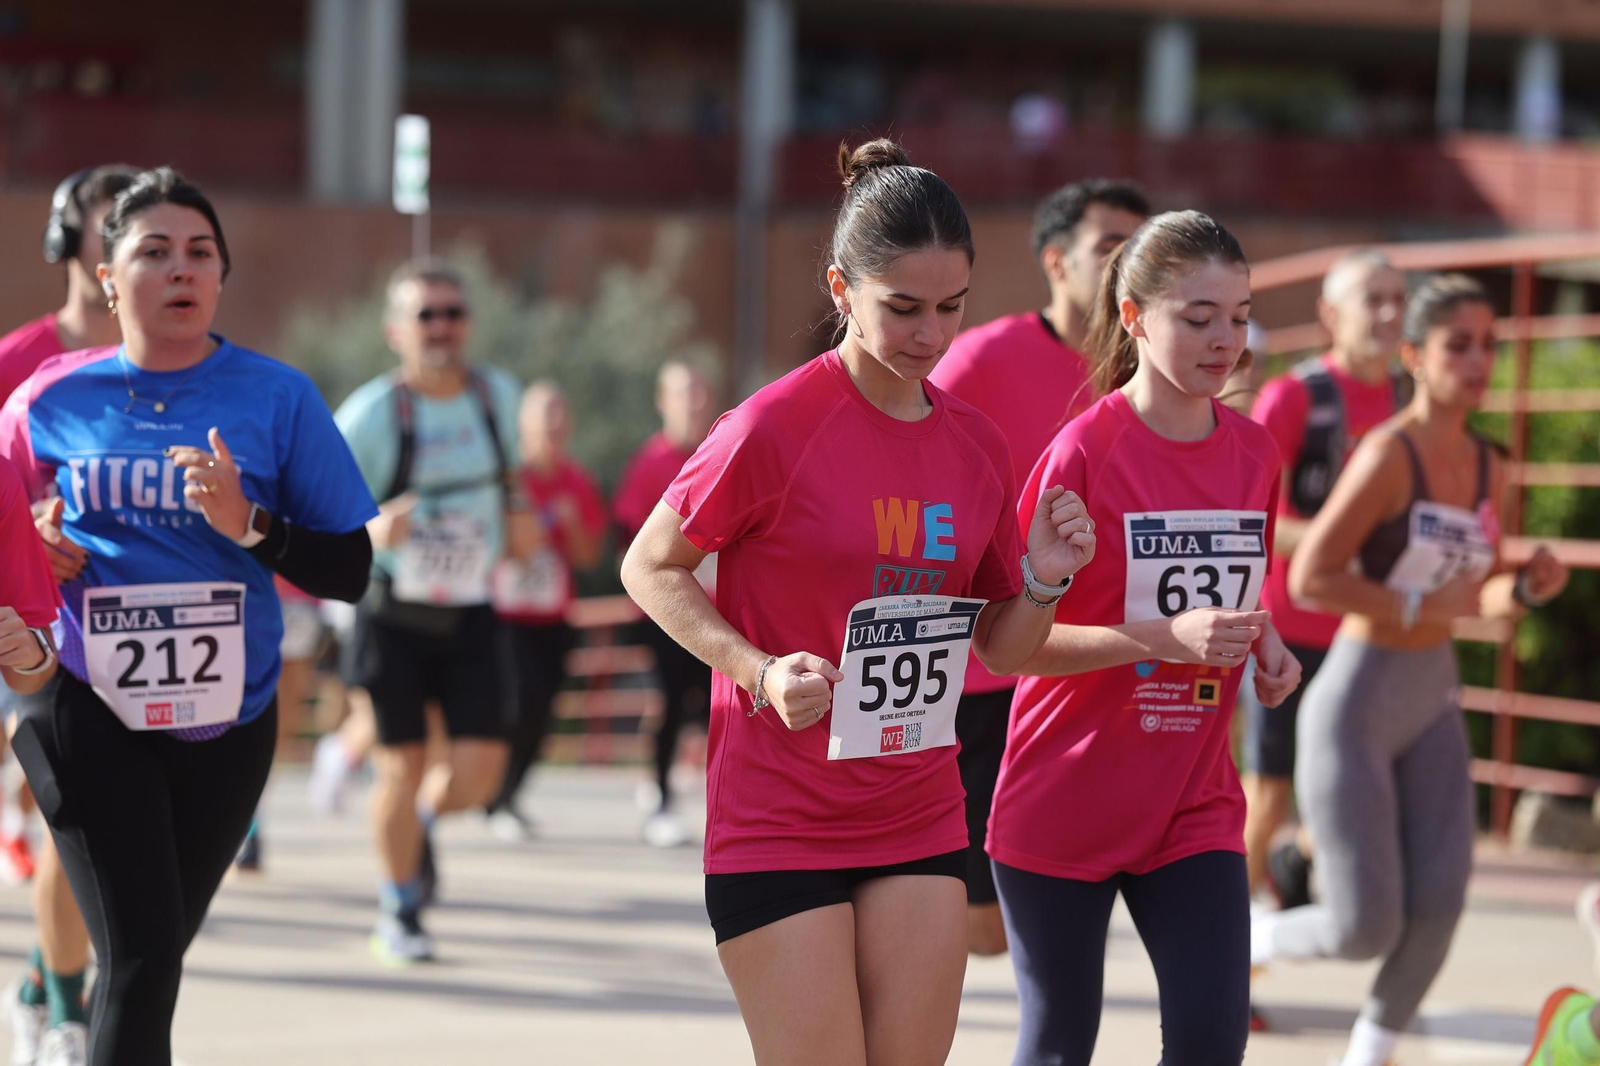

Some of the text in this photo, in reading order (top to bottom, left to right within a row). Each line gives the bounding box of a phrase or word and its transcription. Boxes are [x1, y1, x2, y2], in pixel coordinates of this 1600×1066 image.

[872, 497, 957, 562] WE
[1136, 535, 1203, 555] UMA
[1157, 564, 1251, 617] 637
[900, 602, 922, 610] POPULAR
[92, 609, 165, 631] UMA
[877, 610, 916, 619] UNIVERSIDAD
[916, 609, 923, 617] DE
[947, 621, 969, 630] uma.es
[851, 623, 906, 646] UMA
[116, 635, 222, 688] 212
[859, 649, 949, 712] 595
[1137, 691, 1171, 699] BENEFICIO
[895, 711, 906, 719] RUIZ
[906, 709, 926, 718] ORTEGA
[905, 722, 922, 732] RUN
[1162, 717, 1201, 726] UNIVERSIDAD
[882, 731, 904, 747] WE
[903, 738, 921, 749] RUN
